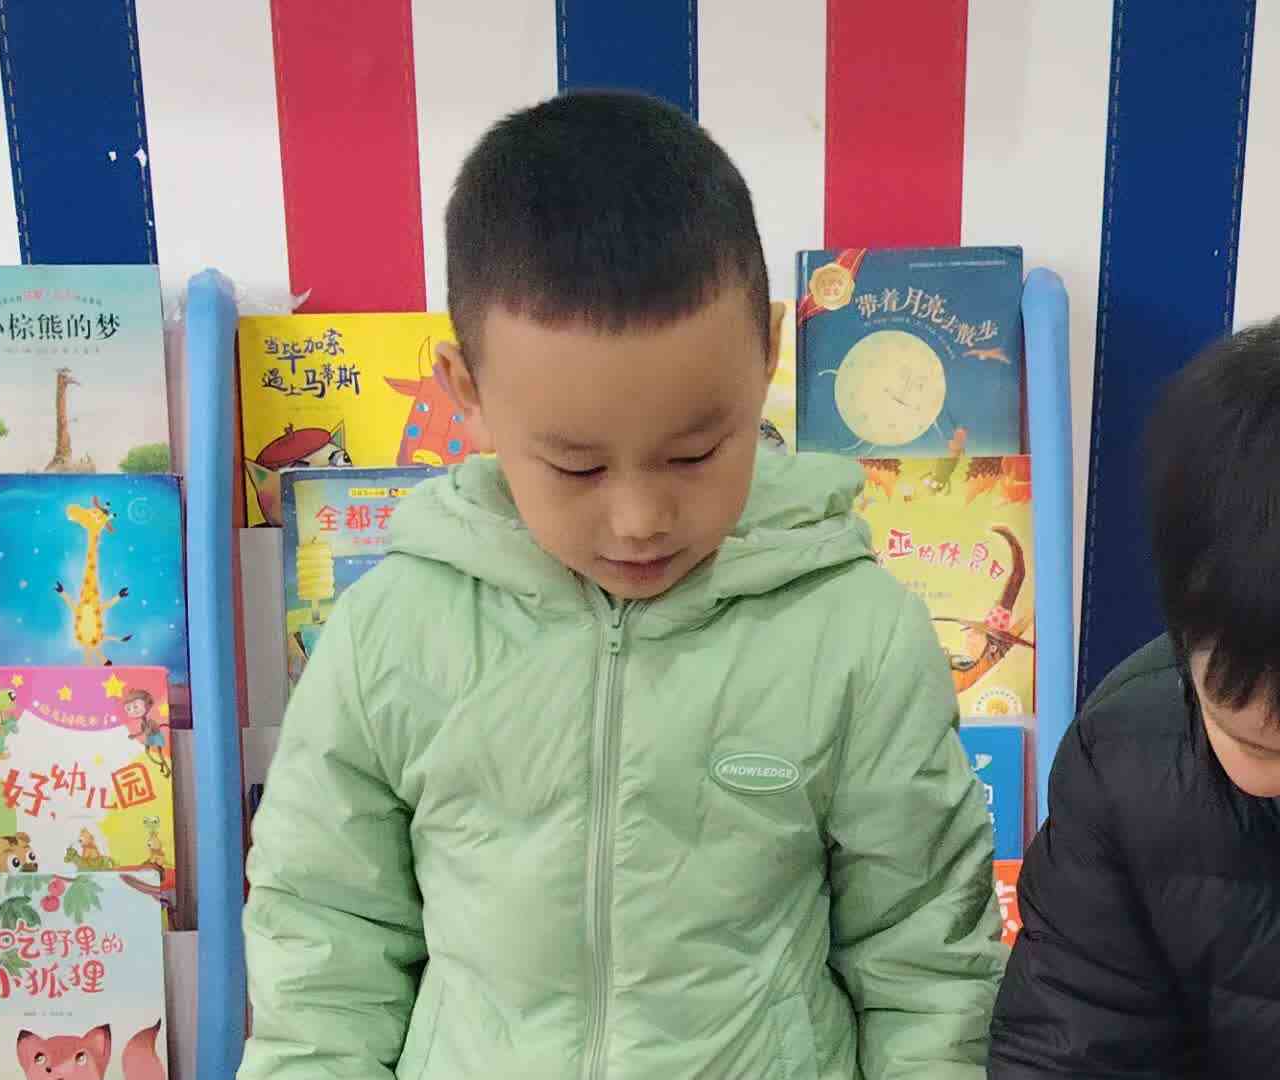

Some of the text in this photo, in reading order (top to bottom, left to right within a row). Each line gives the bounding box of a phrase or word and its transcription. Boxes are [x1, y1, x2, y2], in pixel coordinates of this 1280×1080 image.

[854, 286, 999, 347] 带着月亮去散步
[263, 328, 345, 375] 当毕加索
[261, 362, 361, 399] 遇上马蒂斯
